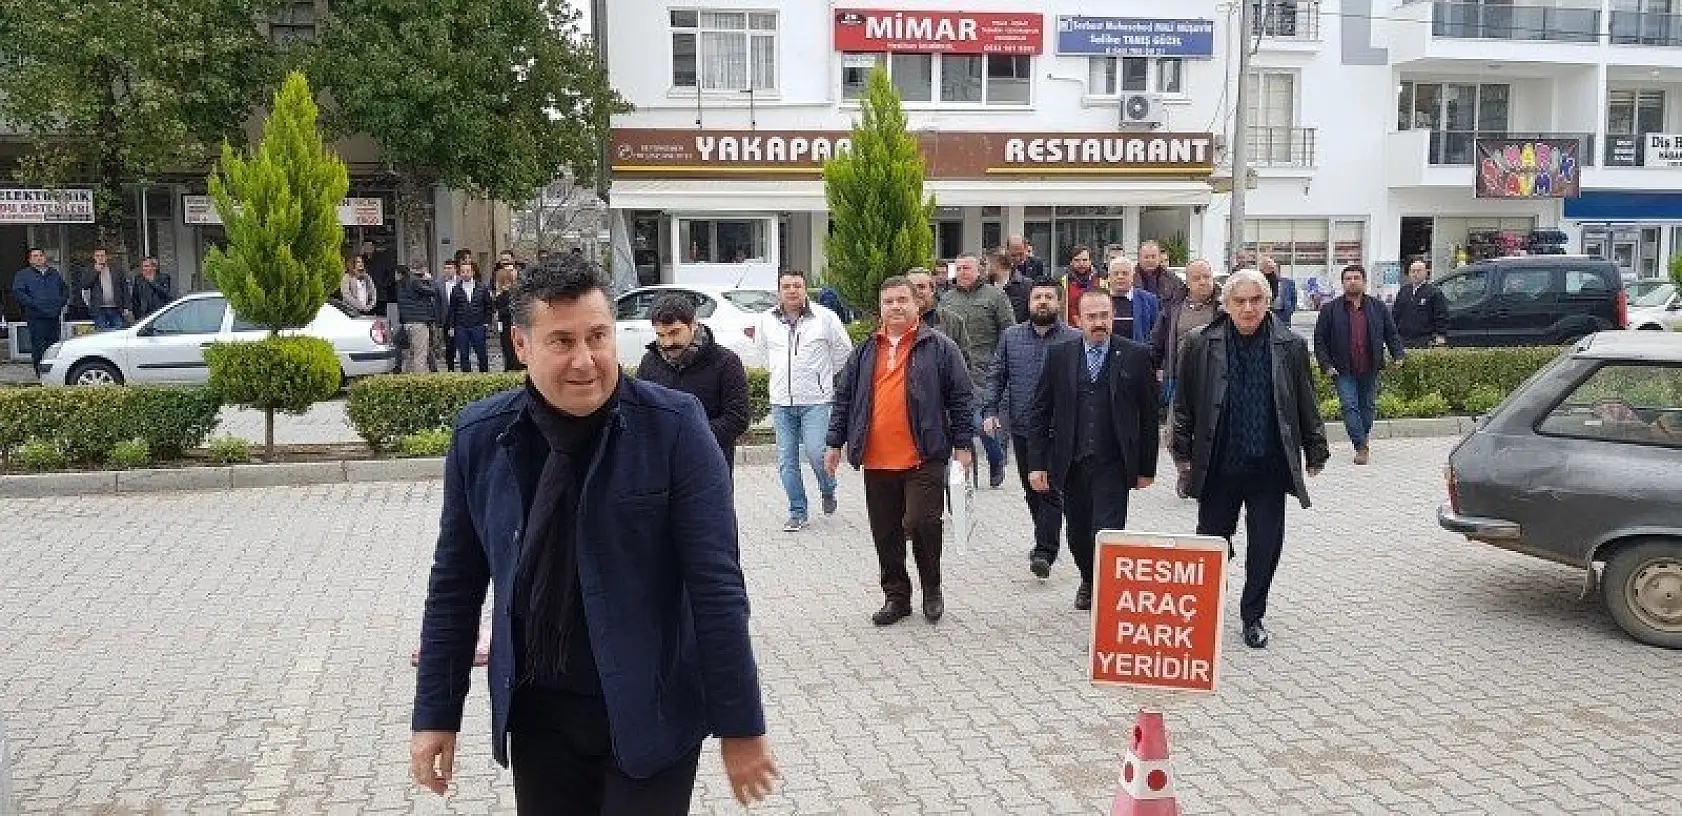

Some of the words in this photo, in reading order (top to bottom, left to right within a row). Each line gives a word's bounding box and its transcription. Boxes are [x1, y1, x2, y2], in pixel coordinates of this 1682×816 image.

[865, 13, 978, 41] MİMAR
[1004, 138, 1210, 163] RESTAURANT
[1115, 557, 1205, 586] RESMİ
[1116, 590, 1197, 622] ARAÇ
[1117, 622, 1194, 649] PARK
[1097, 651, 1210, 682] YERİDİR
